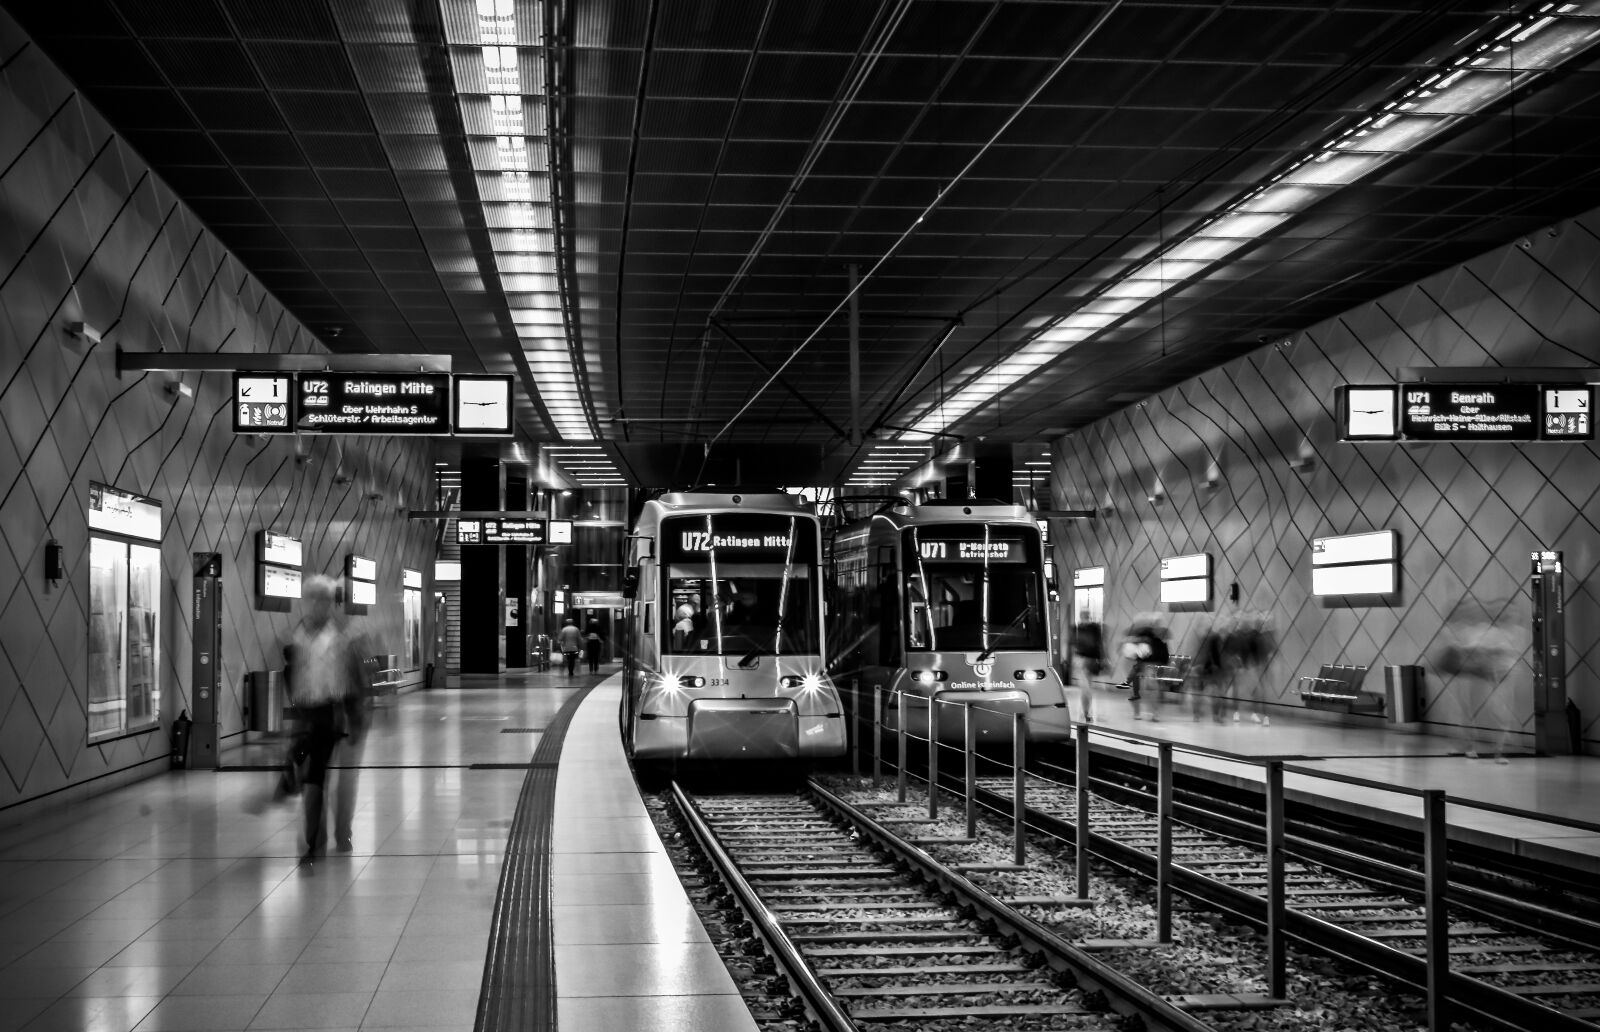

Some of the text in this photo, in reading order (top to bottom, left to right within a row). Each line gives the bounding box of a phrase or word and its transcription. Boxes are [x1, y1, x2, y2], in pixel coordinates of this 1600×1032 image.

[303, 381, 329, 393] U72
[345, 381, 434, 396] Ratingen Mitte
[1408, 392, 1430, 403] U71
[1451, 392, 1495, 403] Benrath
[365, 405, 408, 414] Wehrhahn
[410, 406, 418, 414] S
[308, 413, 361, 424] Schlüterstr.
[371, 414, 438, 425] Arbeitsagentur
[1467, 423, 1513, 431] Holthausen
[682, 532, 710, 551] U72
[713, 535, 760, 548] Ratingen
[921, 542, 946, 558] U71
[951, 681, 977, 689] Online
